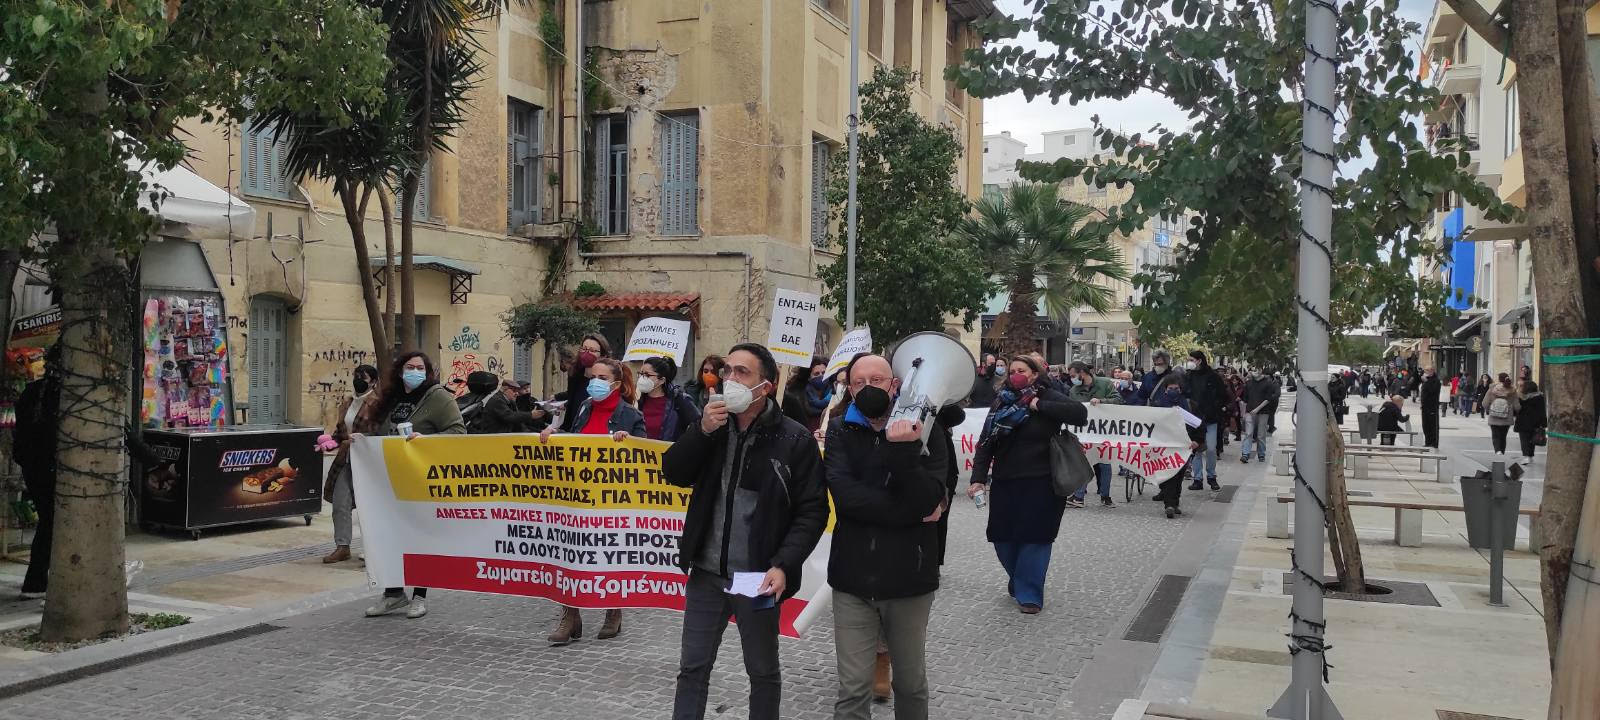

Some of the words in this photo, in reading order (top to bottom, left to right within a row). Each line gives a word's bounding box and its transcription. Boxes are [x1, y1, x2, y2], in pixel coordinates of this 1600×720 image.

[778, 297, 816, 312] ΕΝΤΑΞΗ
[17, 312, 62, 331] TSAKIRIS
[785, 316, 803, 328] ΣΤΑ
[781, 333, 802, 346] ΒΑΕ
[1073, 418, 1156, 439] ΑΚΛΕΙΟΥ
[222, 450, 275, 466] SNICKERS
[512, 445, 564, 462] ΣΠΑΜΕ
[569, 446, 592, 463] ΤΗ
[596, 447, 658, 466] ΣΙΩΠΗ
[426, 464, 554, 480] ΔΥΝΑΜΩΝΟΥΜΕ
[555, 465, 575, 482] ΤΗ
[579, 466, 639, 484] ΦΩΝΗ
[645, 468, 672, 486] ΤΗ
[428, 484, 453, 498] ΓΙΑ
[457, 483, 509, 498] ΜΕΤΡΑ
[511, 484, 596, 507] ΠΡΟΣΤΑΣΙΑΣ,
[601, 489, 631, 504] ΓΙΑ
[636, 490, 673, 506] ΤΗΝ
[436, 507, 488, 520] ΑΜΕΣΕΣ
[490, 508, 543, 523] ΜΑΖΙΚΕΣ
[545, 511, 631, 530] ΠΡΟΣΛΗΨΕΙΣ
[507, 524, 543, 540] ΜΕΣΑ
[546, 527, 620, 548] ΑΤΟΜΙΚΗΣ
[495, 540, 516, 555] ΓΙΑ
[518, 541, 561, 560] ΟΛΟΥΣ
[562, 547, 598, 565] ΤΟΥΣ
[476, 561, 553, 586] Σωματείο
[555, 568, 687, 599] Εργαζομένων
